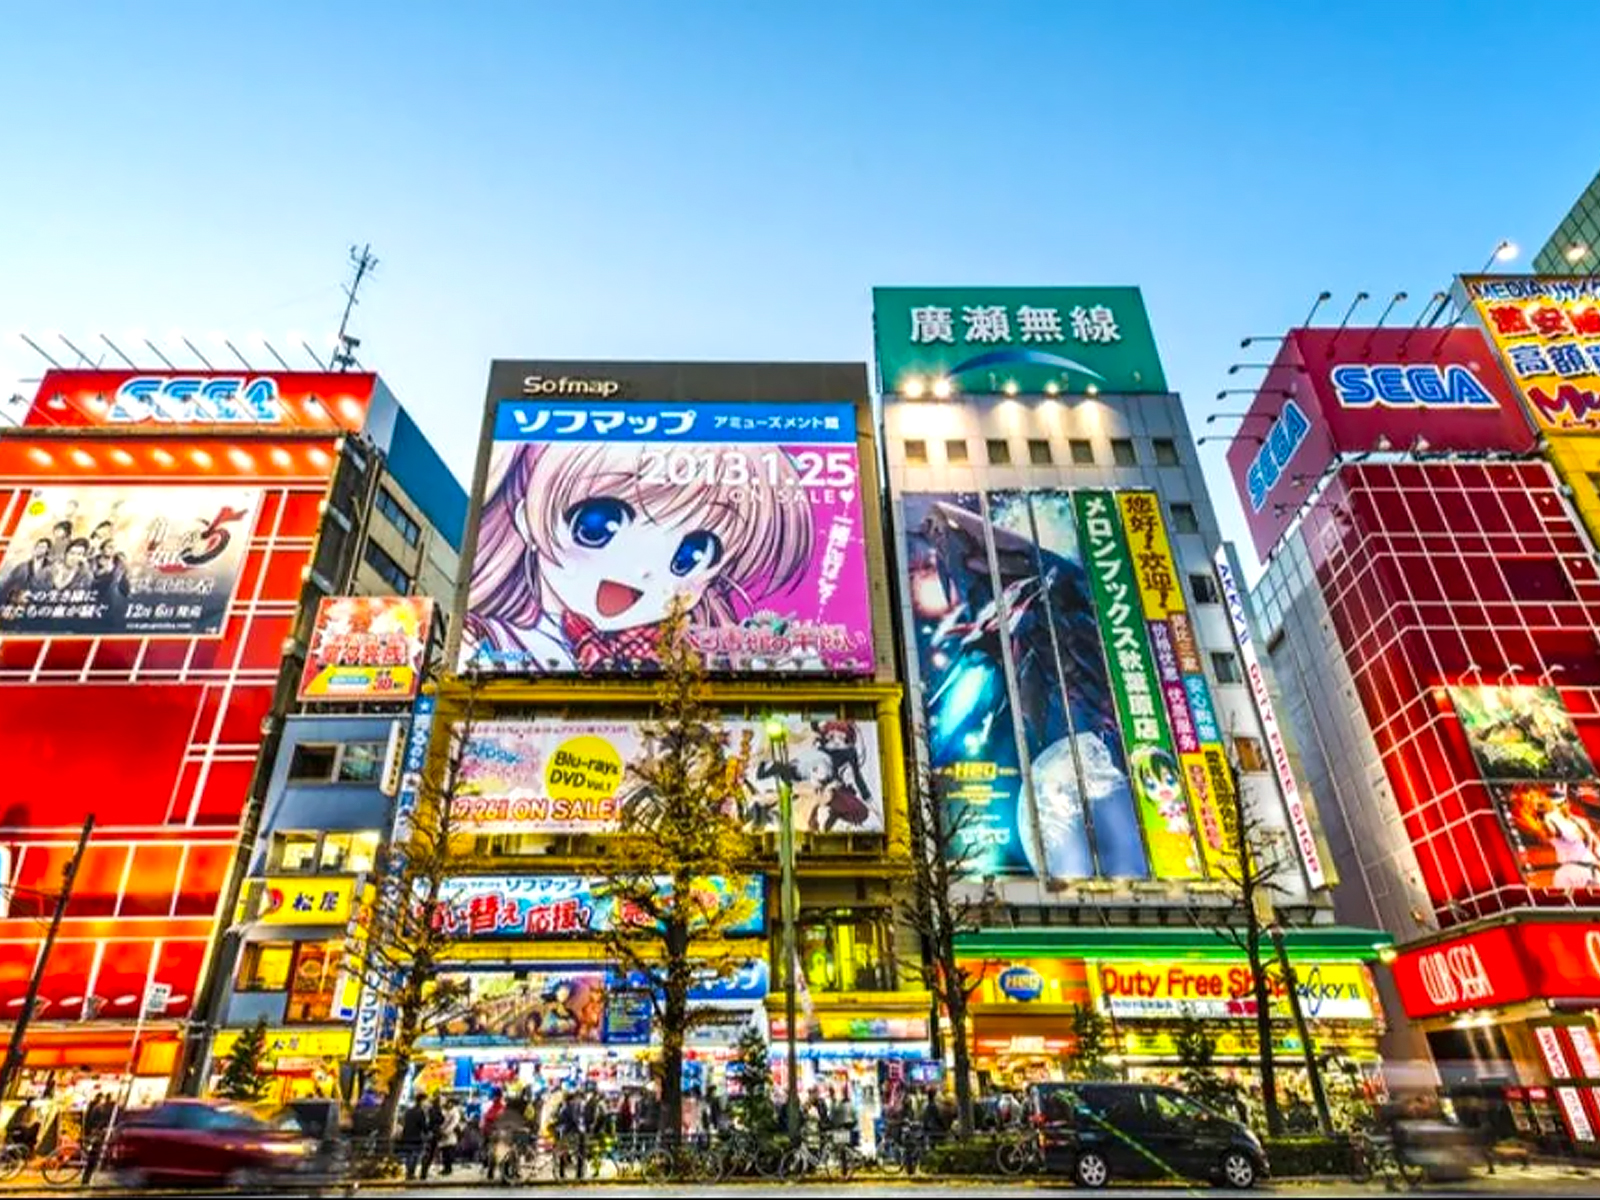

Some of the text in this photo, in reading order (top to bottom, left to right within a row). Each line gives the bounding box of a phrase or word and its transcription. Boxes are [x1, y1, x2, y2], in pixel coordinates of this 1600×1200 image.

[107, 376, 281, 424] SEGA
[522, 375, 620, 397] Sofmap
[1332, 364, 1501, 409] SEGA
[513, 409, 698, 434] ソフマップ
[713, 415, 840, 430] アミューズメント館
[637, 451, 856, 487] 2013.1.25
[1246, 399, 1311, 514] SEGA
[1218, 563, 1245, 625] AKKY
[549, 769, 587, 788] DVD
[1249, 663, 1319, 874] DUTY FREE SHOP
[512, 798, 546, 821] ON
[505, 878, 582, 892] ソフマップ
[292, 891, 340, 912] 松屋
[1101, 967, 1161, 998] Duty
[1167, 968, 1224, 996] Free
